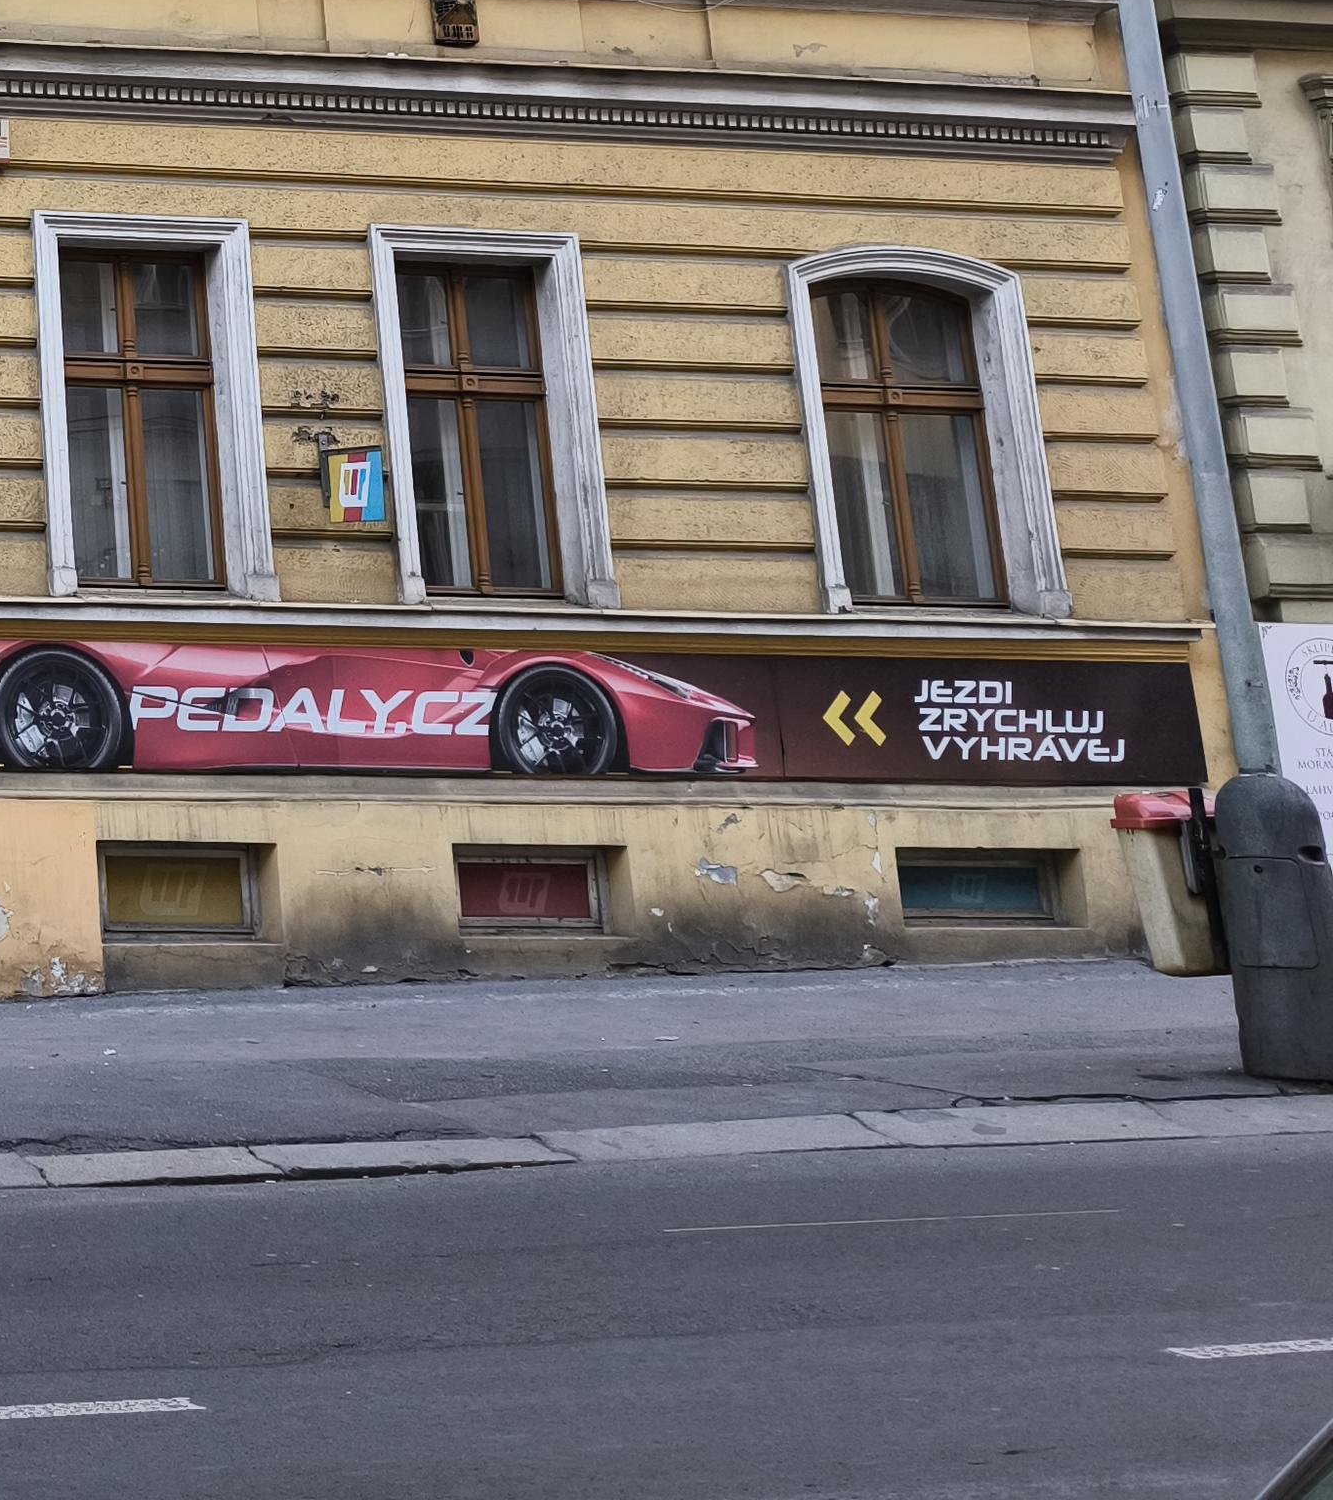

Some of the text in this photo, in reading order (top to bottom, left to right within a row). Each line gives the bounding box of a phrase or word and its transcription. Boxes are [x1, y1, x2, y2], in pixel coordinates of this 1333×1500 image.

[914, 679, 1012, 704] JEZDI
[129, 685, 498, 736] PEDALY.CZ
[918, 708, 1104, 733] ZRYCHLUJ
[921, 735, 1125, 762] VYHRÁVEJ
